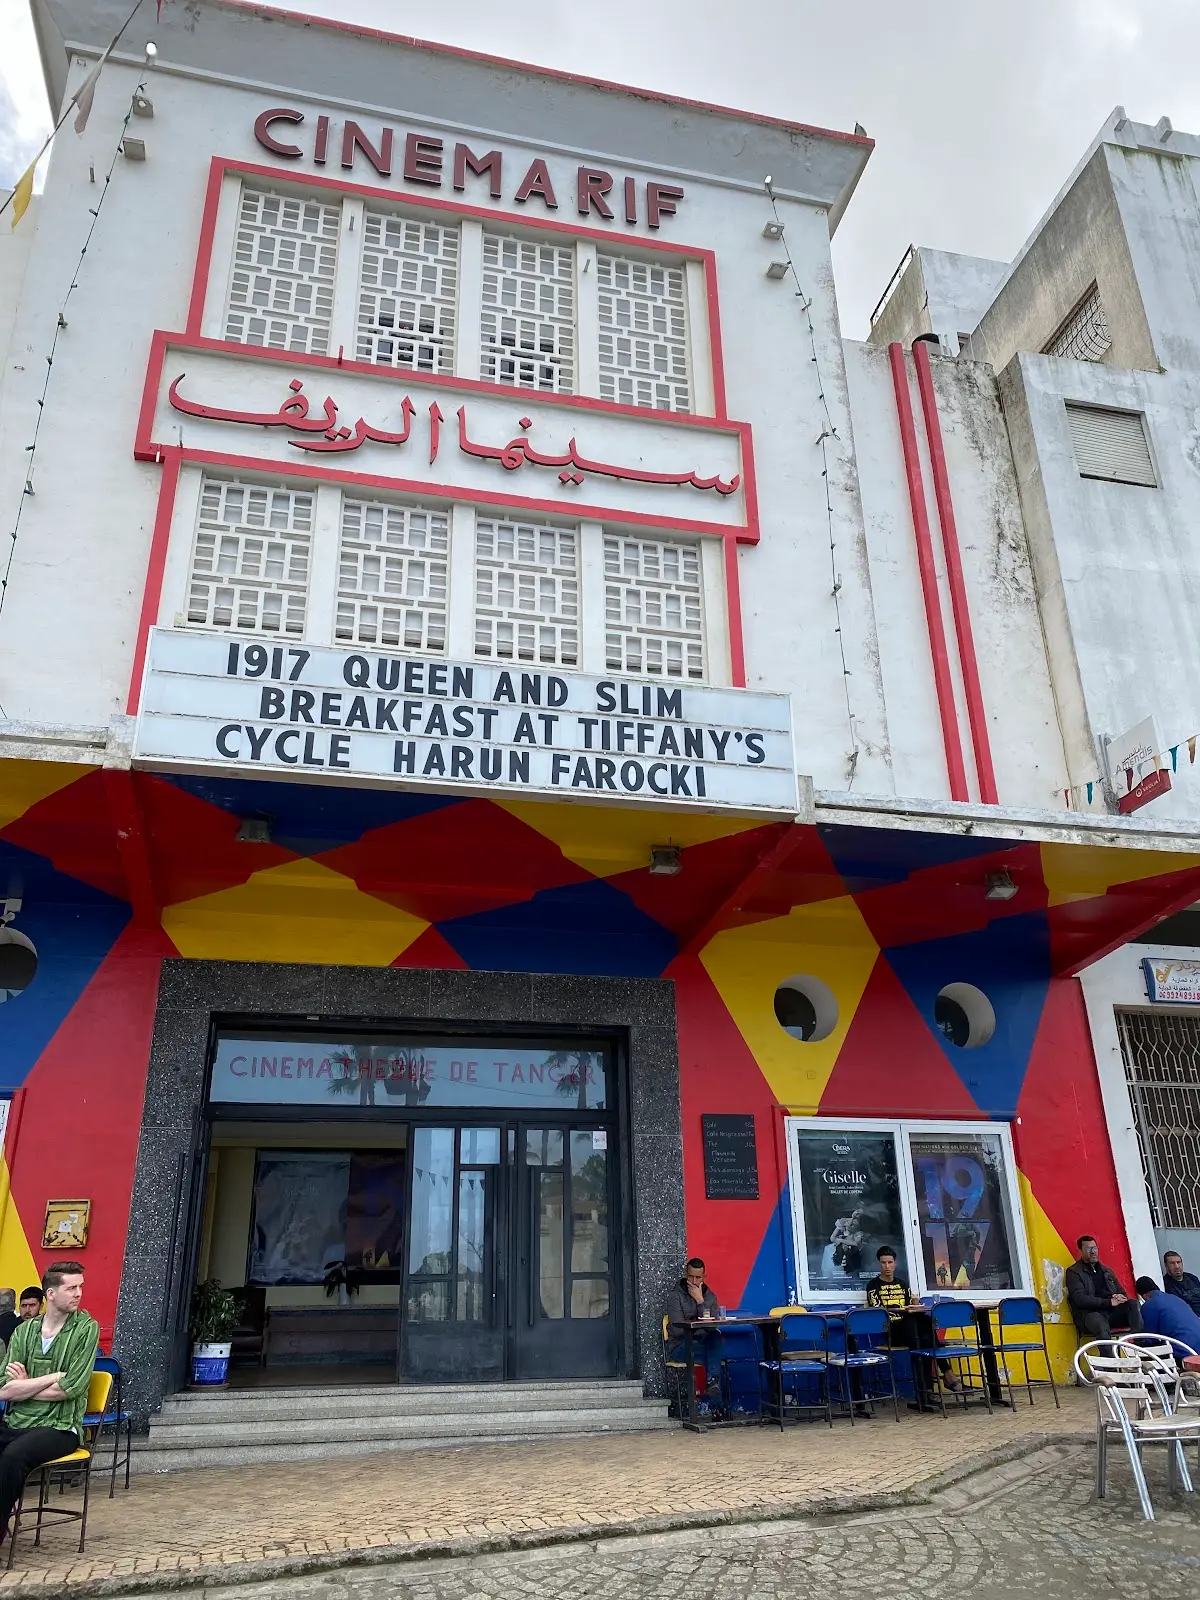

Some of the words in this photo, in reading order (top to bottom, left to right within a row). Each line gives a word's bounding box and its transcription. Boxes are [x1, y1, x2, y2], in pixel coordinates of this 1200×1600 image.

[253, 107, 559, 210] CINEMA
[577, 165, 686, 230] RIF
[167, 378, 444, 466] الريف
[457, 404, 741, 496] سينما
[226, 642, 311, 682] 1917
[343, 654, 473, 699] QUEEN
[492, 671, 569, 707] AND
[596, 681, 682, 719] SLIM
[215, 724, 351, 768] CYCLE
[393, 740, 530, 784] HARUN
[551, 753, 707, 797] FAROCKI
[259, 686, 499, 740] BREAKFAST
[512, 712, 559, 745] AT
[577, 717, 765, 764] TIFFANY'S
[1116, 745, 1153, 775] Amendis
[450, 1060, 478, 1083] DE
[493, 1061, 596, 1086] TANGER
[822, 1167, 867, 1184] Giselle
[917, 1156, 985, 1219] 19
[925, 1222, 991, 1287] 17
